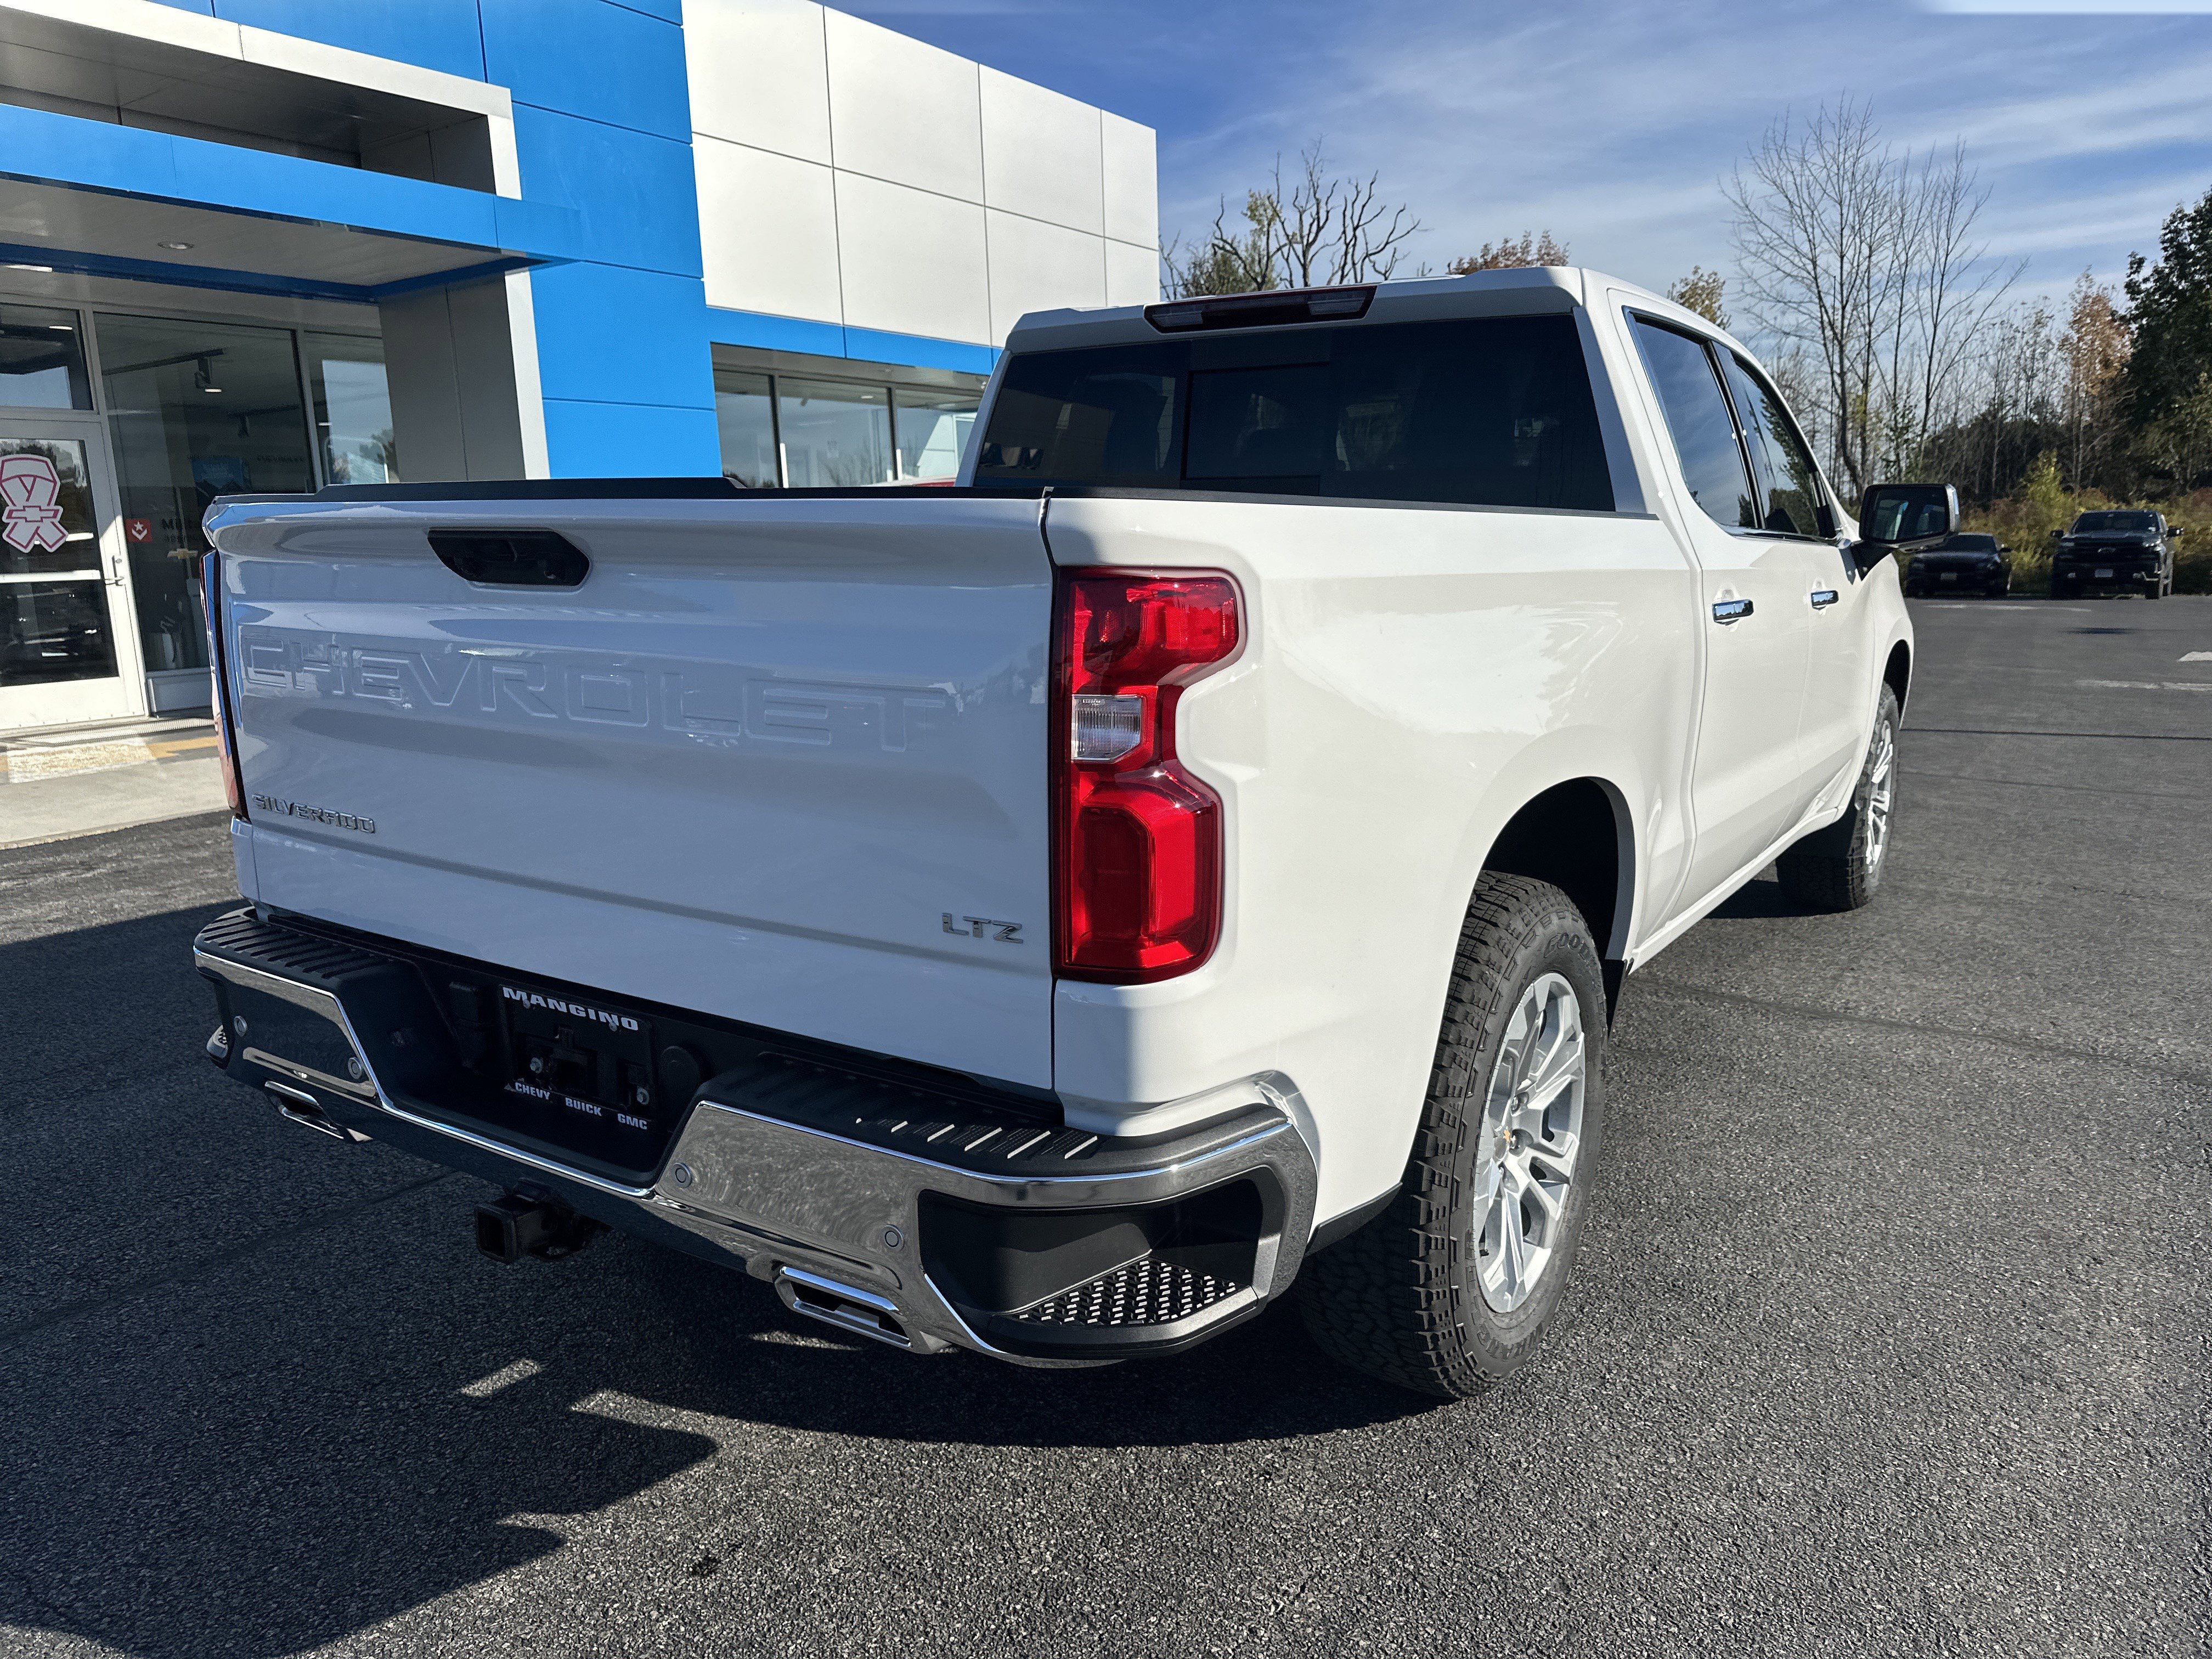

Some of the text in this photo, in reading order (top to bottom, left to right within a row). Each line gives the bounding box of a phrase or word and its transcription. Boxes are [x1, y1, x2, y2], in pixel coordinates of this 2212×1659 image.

[242, 635, 947, 752] CHEVROLET
[252, 793, 376, 834] SILVERADO
[941, 912, 1024, 944] LTZ
[502, 986, 639, 1031] MANGINO
[515, 1082, 647, 1130] CHEVY BUICK GMC
